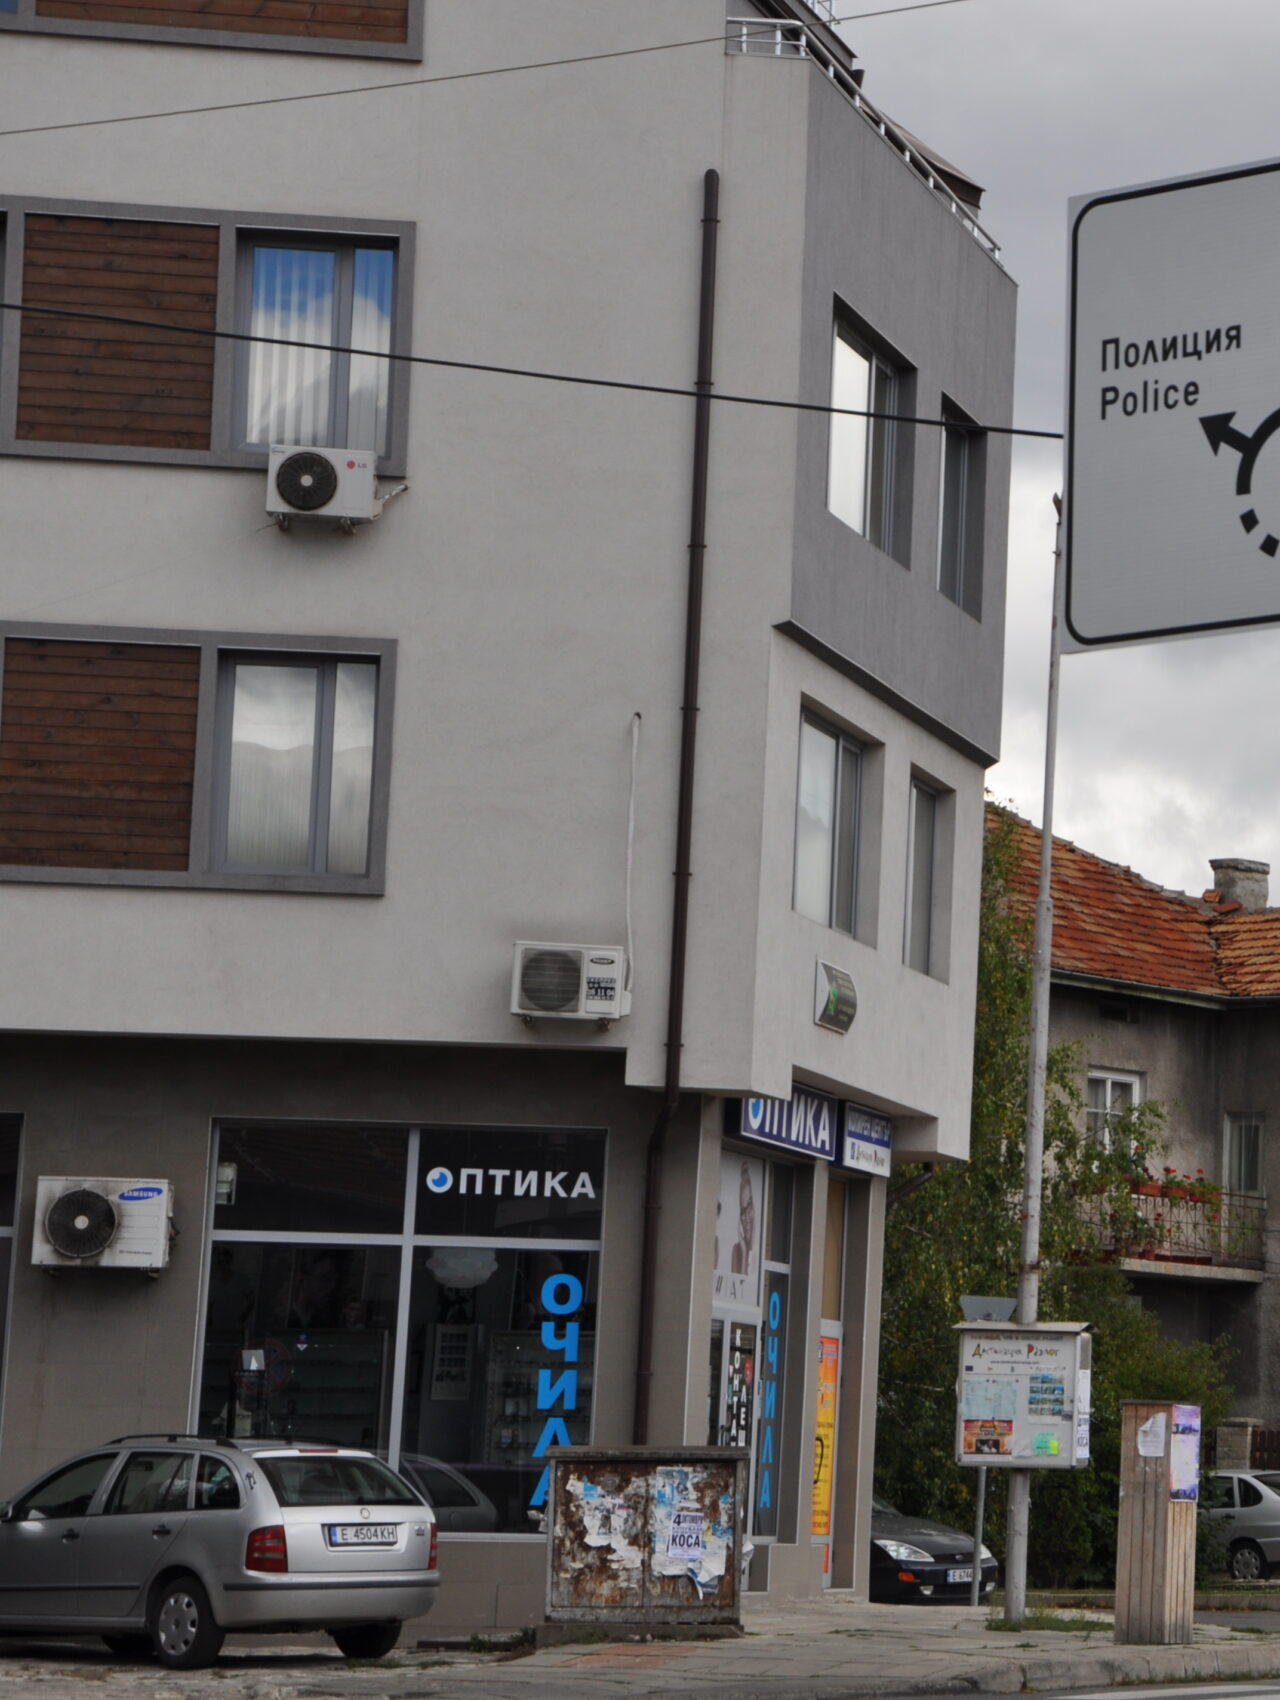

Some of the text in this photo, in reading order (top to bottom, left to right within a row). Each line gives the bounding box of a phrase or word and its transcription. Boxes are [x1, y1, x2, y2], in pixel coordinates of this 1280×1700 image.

[1101, 324, 1242, 373] Полиция
[1100, 379, 1201, 421] Police
[123, 1189, 159, 1198] SAMSUNG
[426, 1166, 596, 1199] ОПТИКА
[759, 1291, 781, 1508] ОЧИЛА
[673, 1513, 681, 1526] 4
[671, 1534, 700, 1548] КОСА
